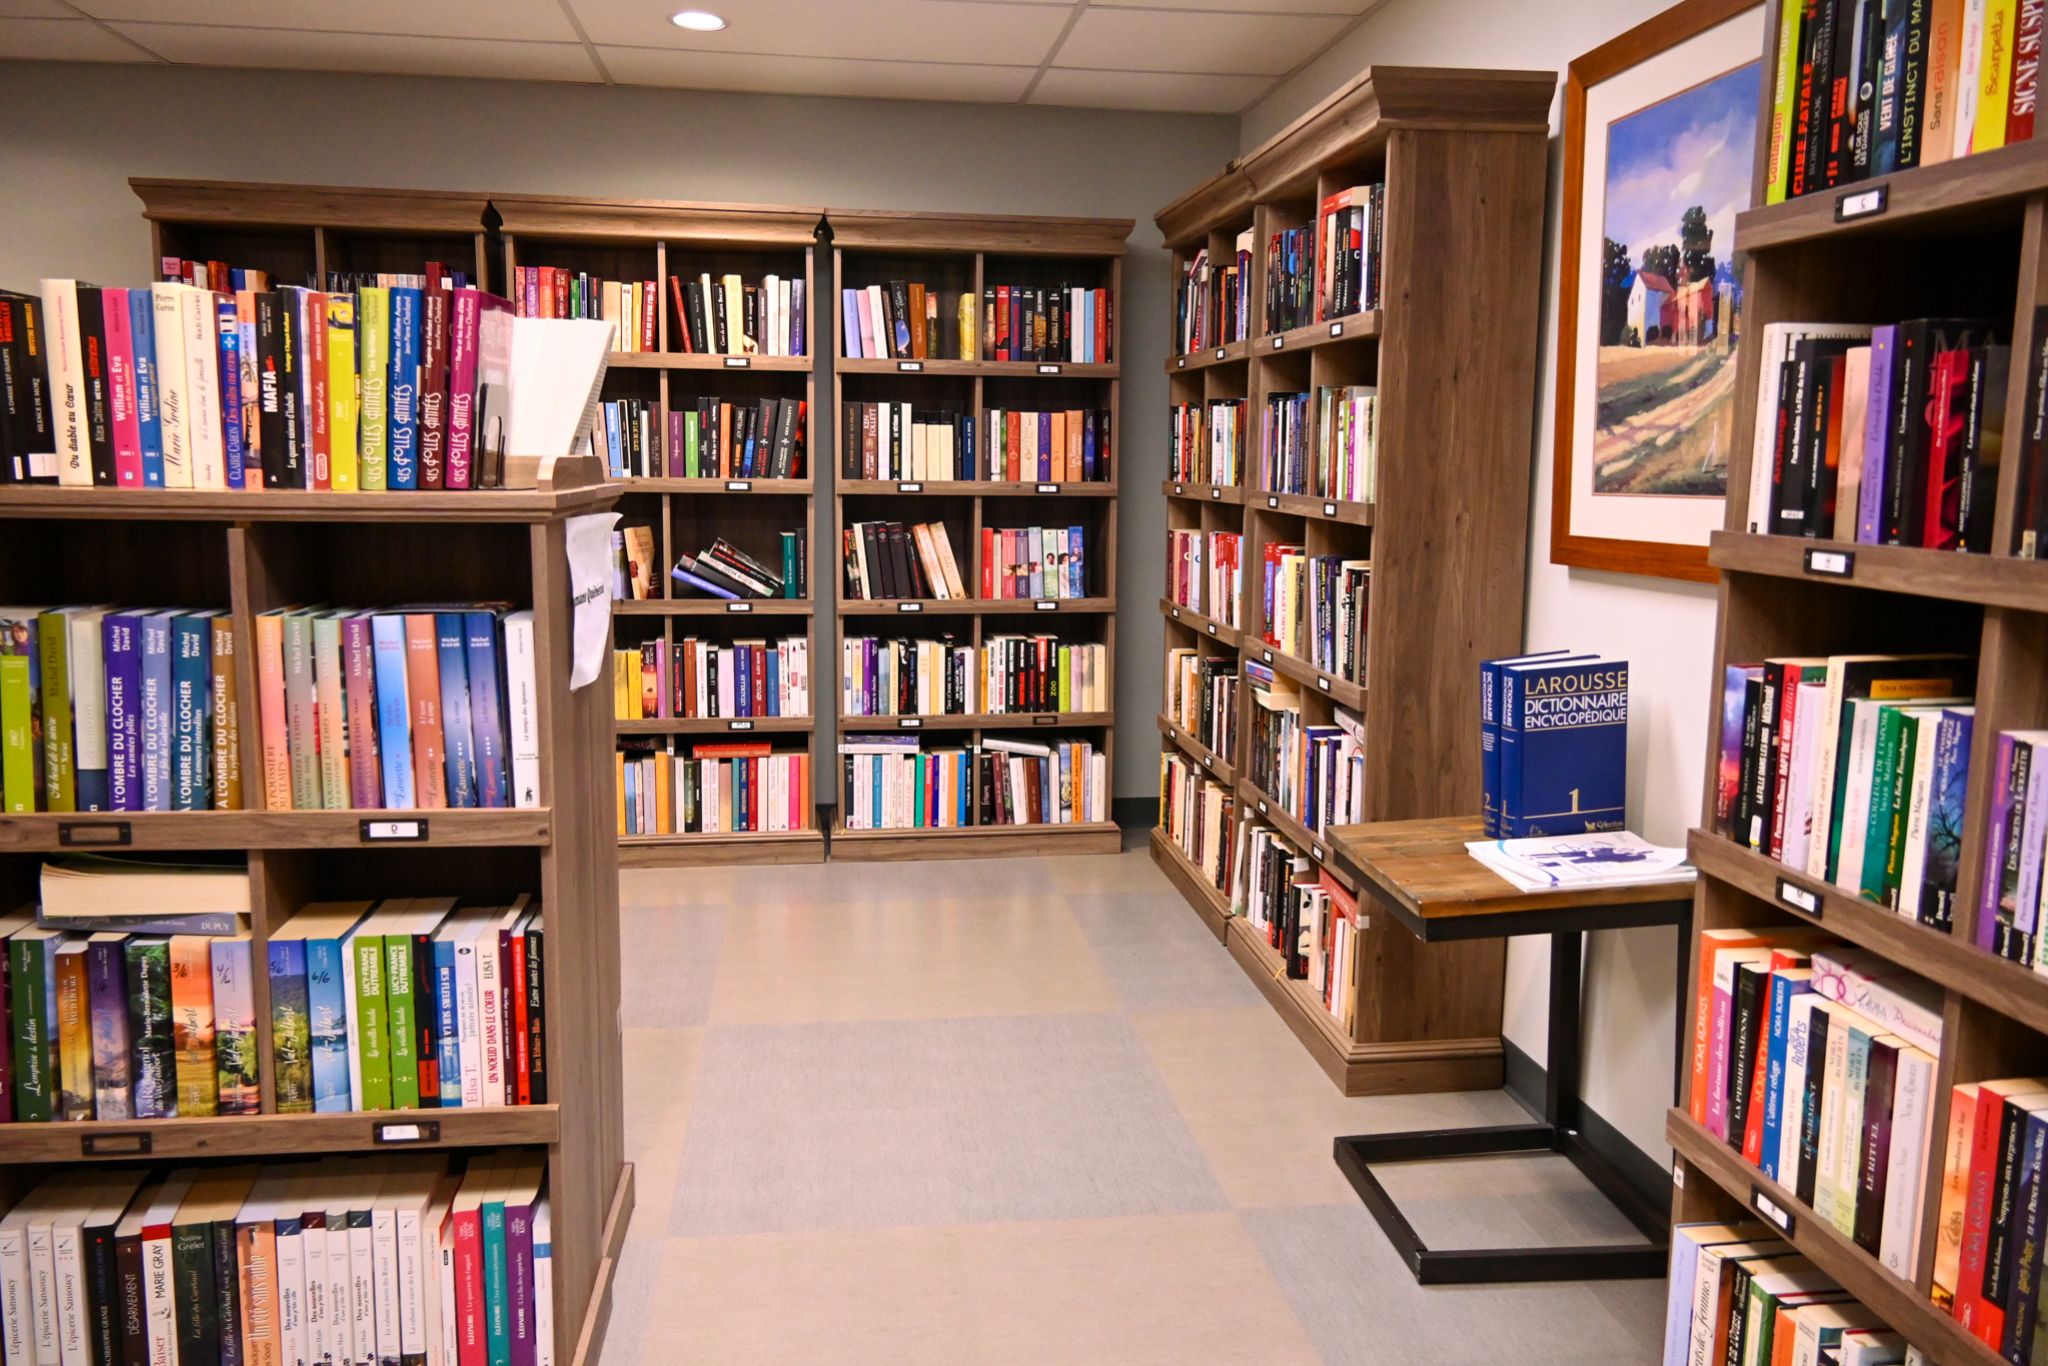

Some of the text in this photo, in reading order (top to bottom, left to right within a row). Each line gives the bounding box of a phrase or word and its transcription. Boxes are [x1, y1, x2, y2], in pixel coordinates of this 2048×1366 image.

[1985, 10, 2005, 97] Scarpetta
[1879, 32, 1897, 131] VENT DE GLACE
[1900, 0, 1924, 164] L'INSTINCT DU MA
[2012, 59, 2038, 116] SIGNE
[1793, 63, 1813, 195] CURE FATALE
[403, 296, 411, 325] Charland
[2, 348, 11, 371] OUVERTE
[112, 356, 122, 373] Eva
[137, 357, 147, 373] Eva
[114, 384, 126, 421] William
[139, 386, 151, 422] William
[262, 371, 278, 412] MAFIA
[285, 392, 295, 419] d'Isabelle
[66, 426, 77, 451] diable
[67, 412, 75, 422] au
[95, 425, 105, 442] Alex
[225, 373, 241, 480] CLAIRE CARON Des ailes au
[287, 420, 296, 439] saisons
[390, 384, 412, 465] FOLLES ANNÉES
[419, 392, 441, 466] FOLLES ANNÉES
[70, 455, 79, 469] Du
[287, 459, 296, 468] Les
[112, 626, 130, 652] Michel David
[351, 624, 362, 677] Michel David
[1524, 671, 1627, 696] LAROUSSE
[1524, 692, 1627, 715] DICTIONNAIRE
[112, 677, 126, 803] L'OMBRE DU CLOCHER
[146, 679, 158, 802] L'OMBRE DU CLOCHER
[180, 681, 192, 803] L'OMBRE DU CLOCHER
[193, 709, 202, 744] interdites
[216, 675, 228, 808] À L'OMBRE DU CLOCHER
[1524, 709, 1627, 729] ENCYCLOPÉDIQUE
[126, 714, 136, 778] Les années folles
[1779, 719, 1792, 776] RAPT DE NUIT
[1873, 759, 1883, 772] DE
[193, 775, 202, 786] Les
[1569, 788, 1579, 814] 1
[1869, 775, 1882, 825] COULEUR
[369, 946, 379, 995] DUTREMBLE
[390, 945, 401, 995] LUCY-FRANCE
[398, 944, 409, 993] DUTREMBLE
[483, 960, 494, 979] ELISA
[528, 936, 539, 960] femmes
[361, 947, 371, 997] LUCY-FRANCE
[530, 969, 540, 987] toutes
[441, 982, 451, 1024] FLEURS SUR
[529, 988, 540, 1007] Entre
[1774, 980, 1785, 1037] NORA ROBERTS
[467, 1010, 477, 1037] jamais
[483, 990, 498, 1083] UN NOEUD DANS LE COEUR
[22, 1018, 41, 1096] L'emprise destin
[532, 1059, 543, 1073] Jean
[464, 1064, 478, 1103] Élisa T.
[1766, 1059, 1780, 1128] L'ultime refuge
[1865, 1122, 1879, 1192] LE RITUEL
[151, 1244, 166, 1298] MARIE GRAY
[8, 1279, 21, 1355] L'épicerie Sansoucy
[38, 1270, 51, 1347] L'épicerie Sansoucy
[64, 1273, 77, 1351] L'épicerie Sansoucy
[126, 1273, 140, 1335] DÉSARMEMENT
[244, 1255, 271, 1340] Un été sans aube
[308, 1280, 319, 1323] Des nouvelles
